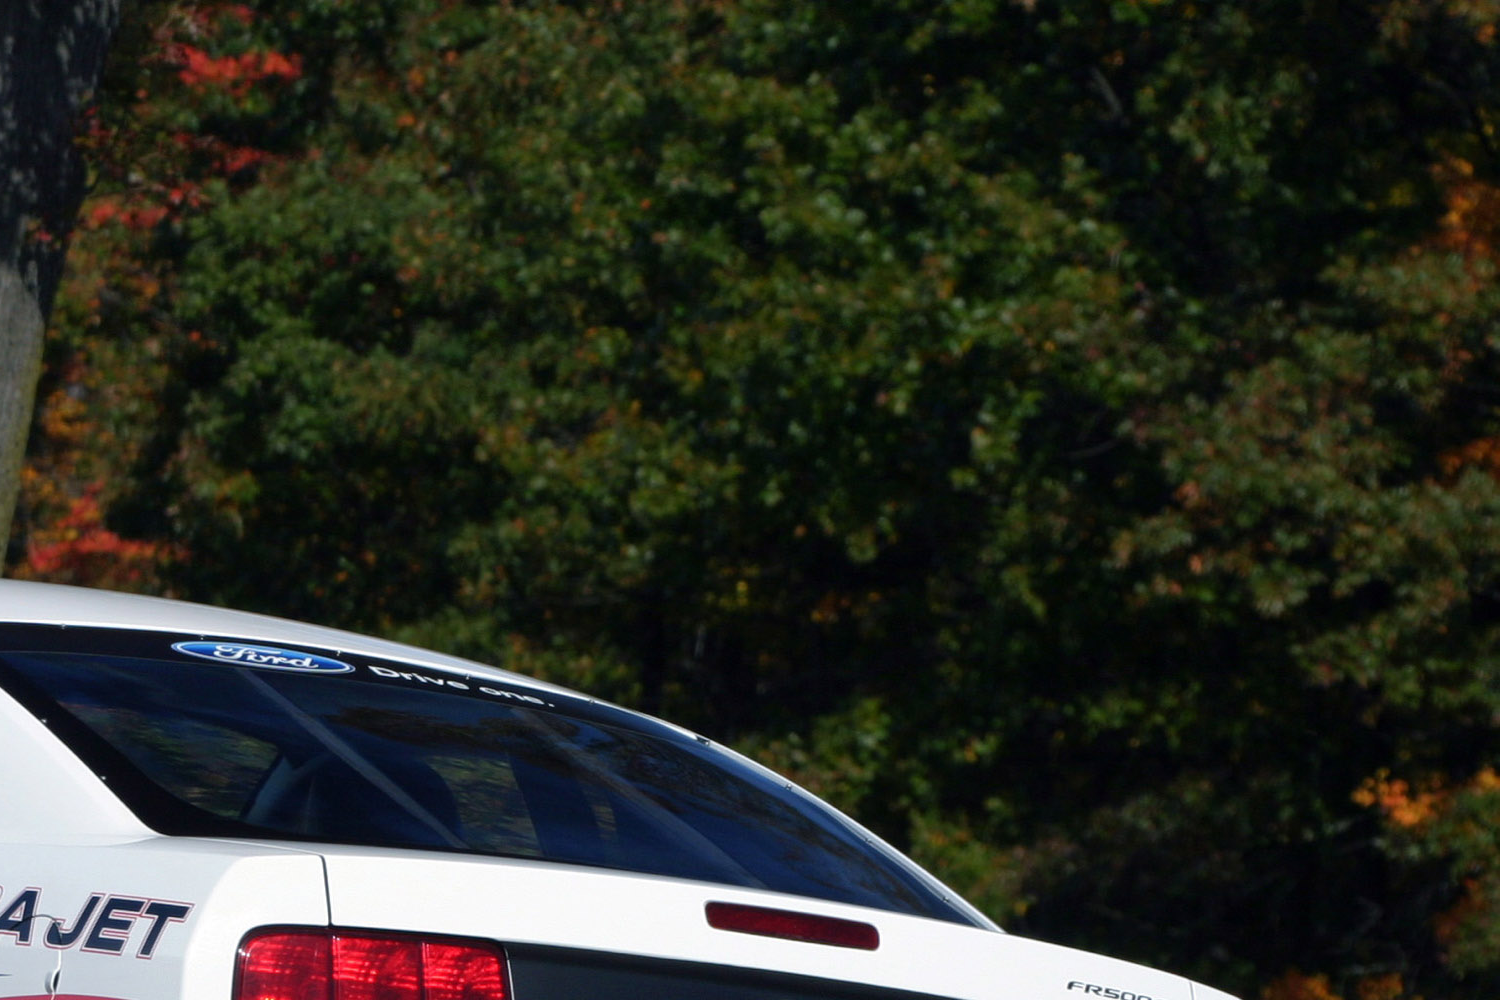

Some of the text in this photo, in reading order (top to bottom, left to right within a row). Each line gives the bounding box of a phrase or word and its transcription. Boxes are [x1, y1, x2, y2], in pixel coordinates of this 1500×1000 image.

[213, 644, 319, 670] Ford
[367, 665, 556, 708] Drive one.
[43, 891, 196, 961] JET
